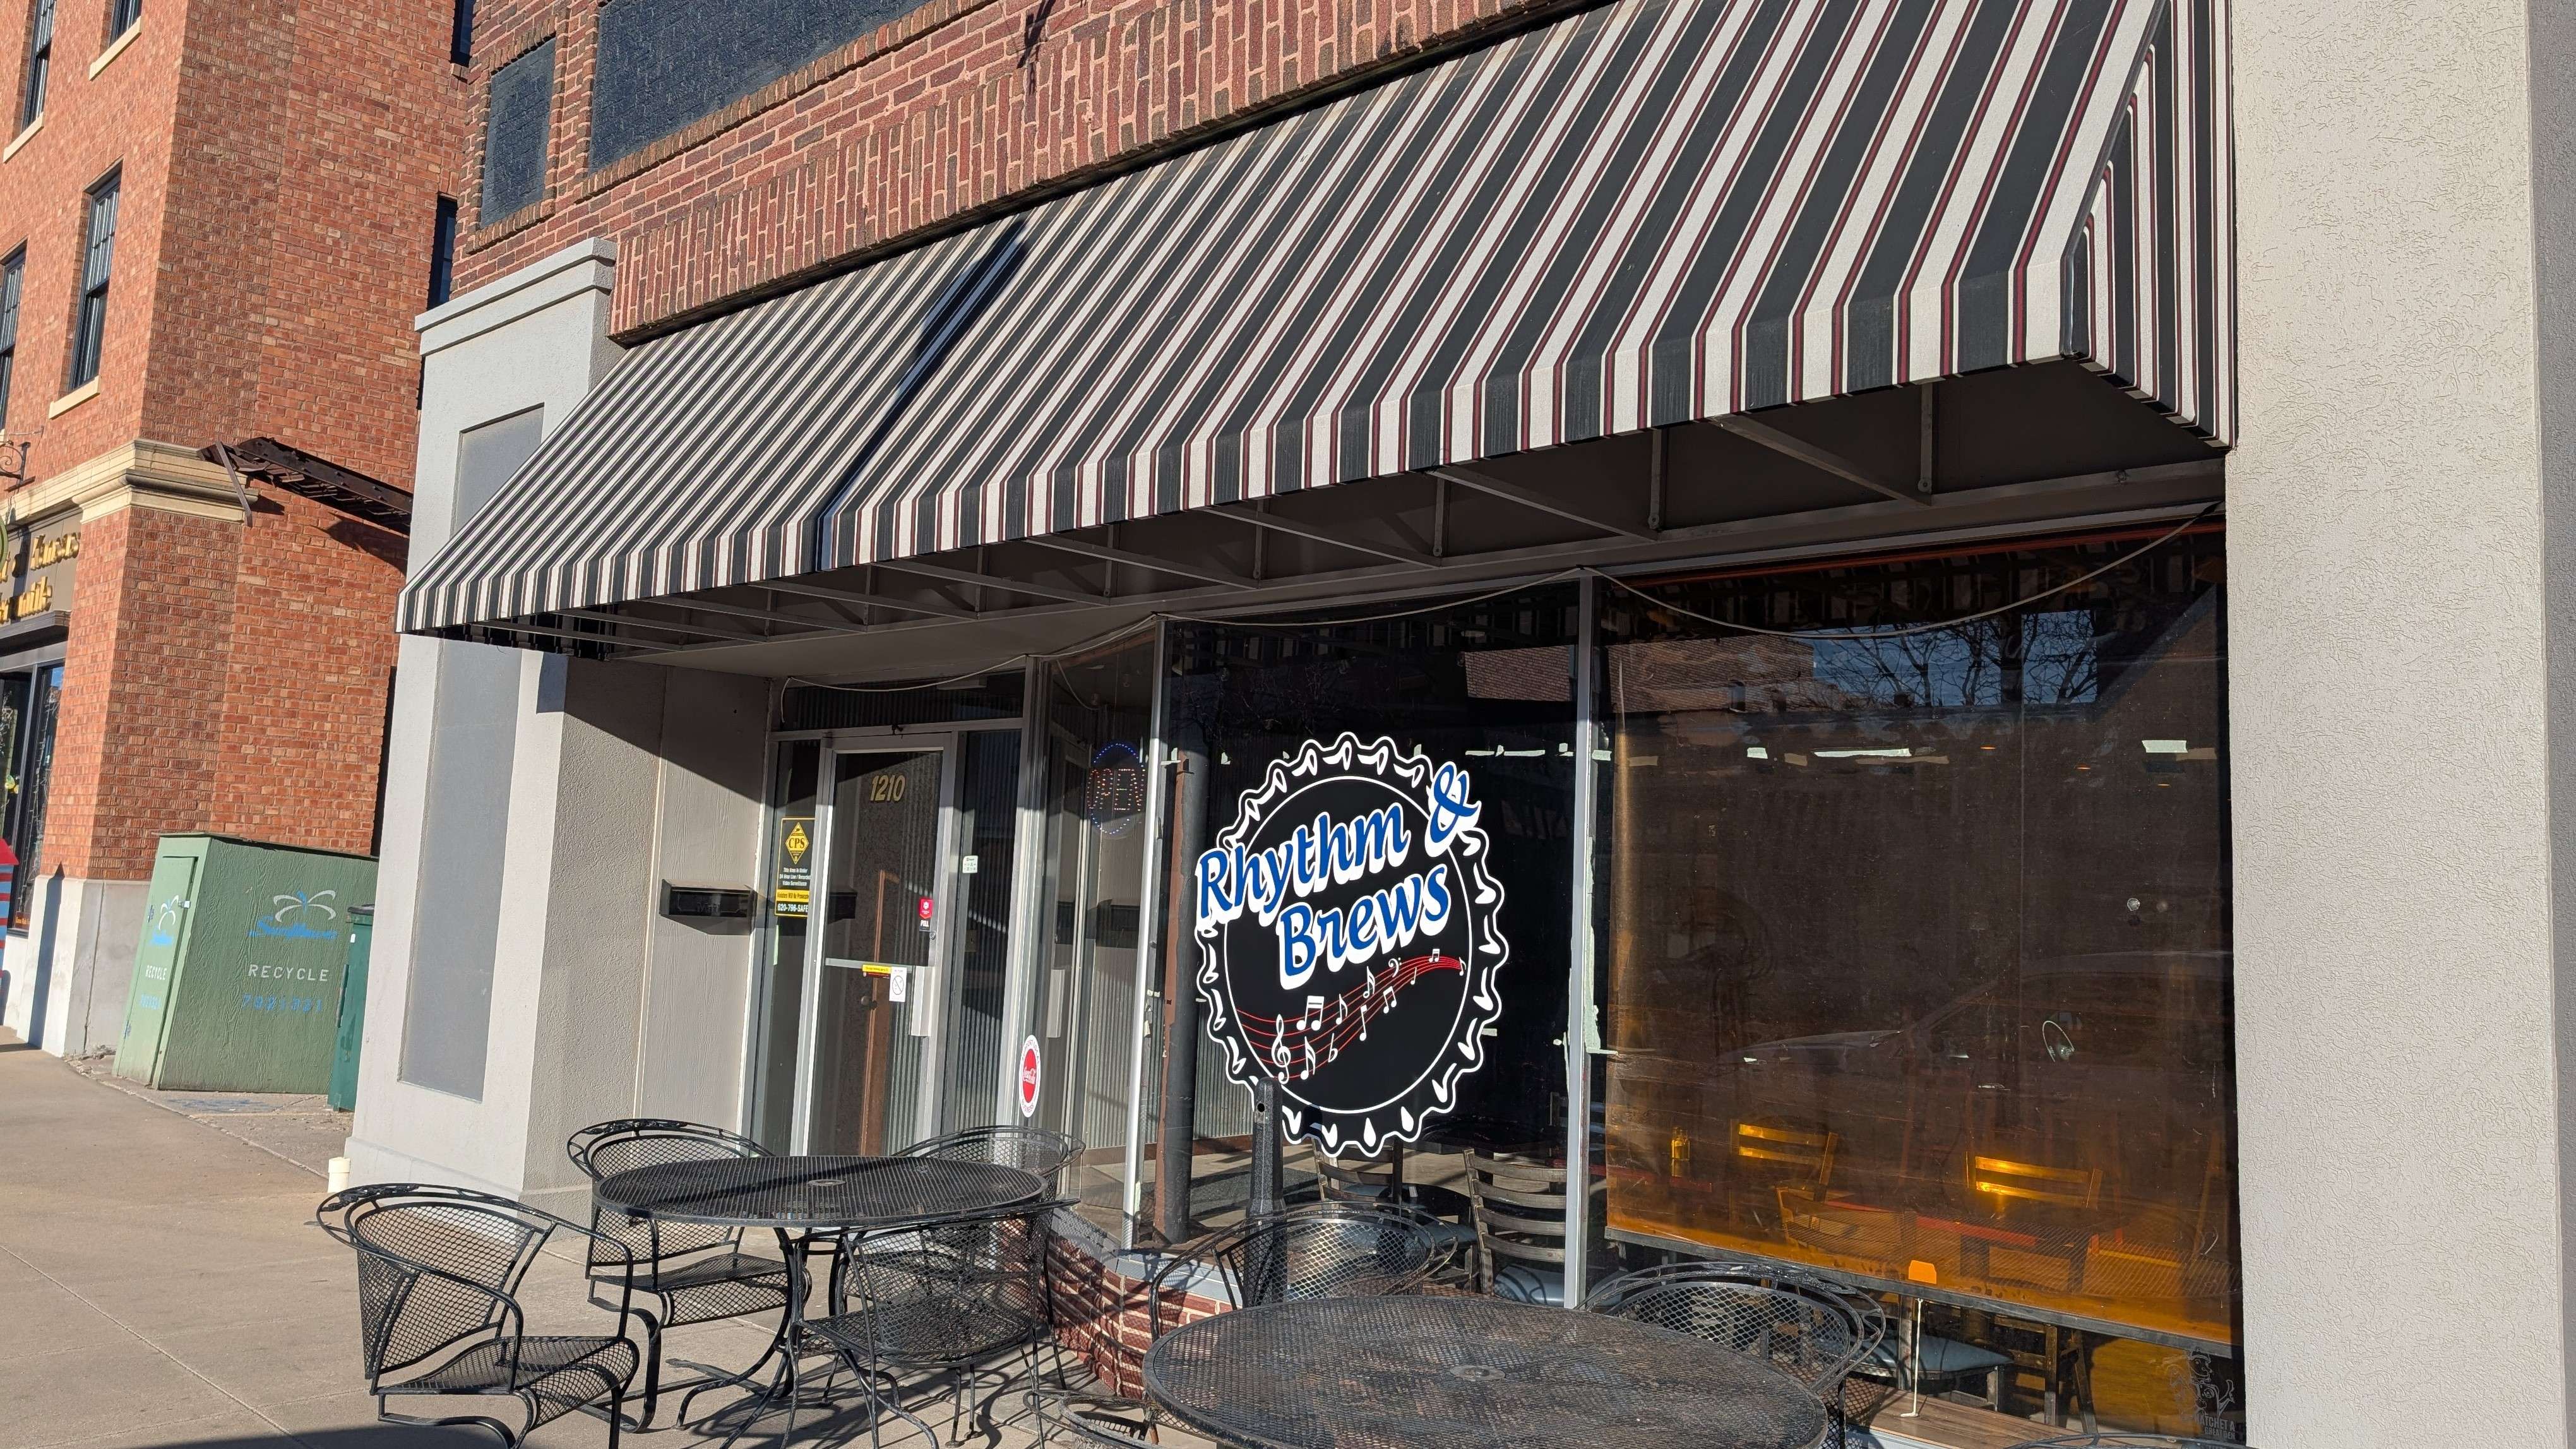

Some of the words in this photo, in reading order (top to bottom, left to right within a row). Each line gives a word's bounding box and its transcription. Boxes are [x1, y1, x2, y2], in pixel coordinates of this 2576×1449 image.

[871, 775, 905, 801] 1210
[1087, 768, 1143, 811] OPEN
[789, 838, 805, 849] CPS
[1197, 802, 1410, 925] Rhythm
[1427, 762, 1480, 852] &
[1278, 865, 1450, 983] Brews
[146, 964, 167, 981] RECYCLE
[247, 964, 329, 982] RECYCLE
